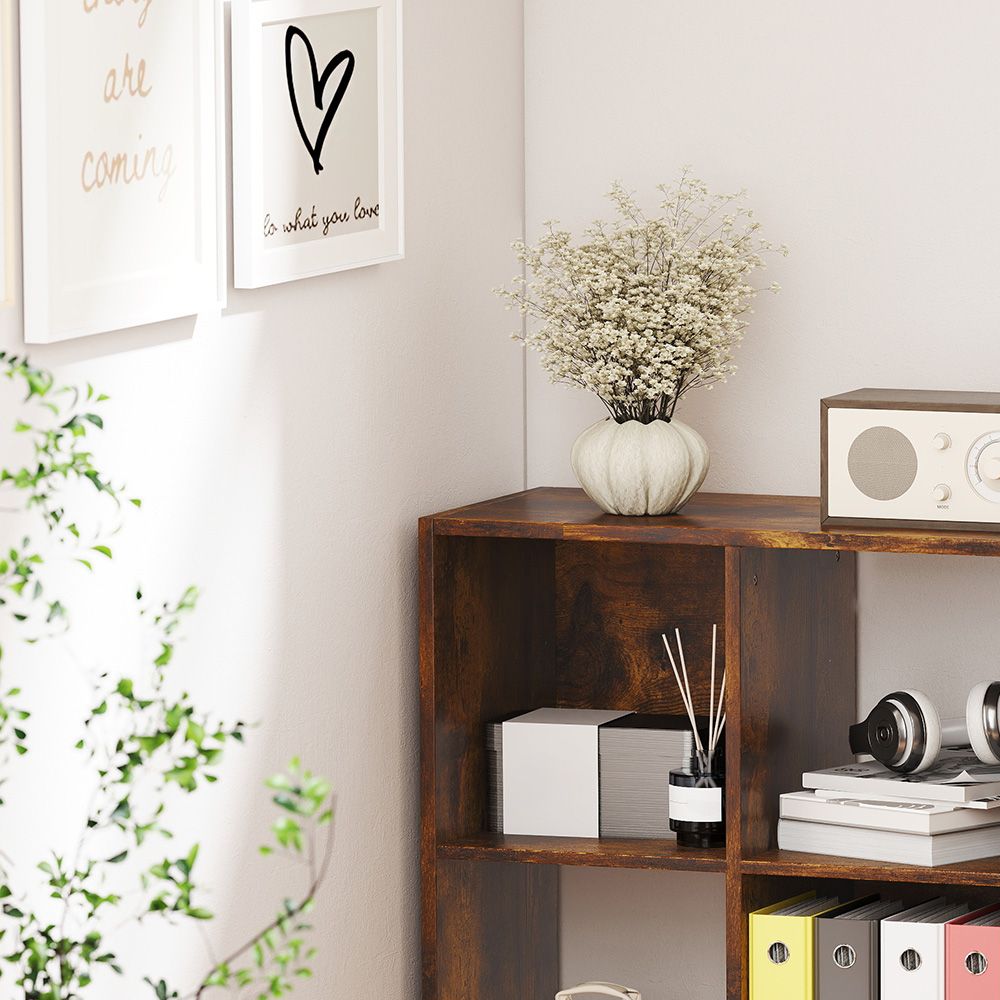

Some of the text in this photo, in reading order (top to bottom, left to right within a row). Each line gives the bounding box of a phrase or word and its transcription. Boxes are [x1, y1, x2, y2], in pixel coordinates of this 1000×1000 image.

[103, 53, 153, 103] are
[81, 133, 177, 202] coming
[282, 205, 318, 232] what
[321, 211, 350, 235] you
[353, 197, 379, 220] love
